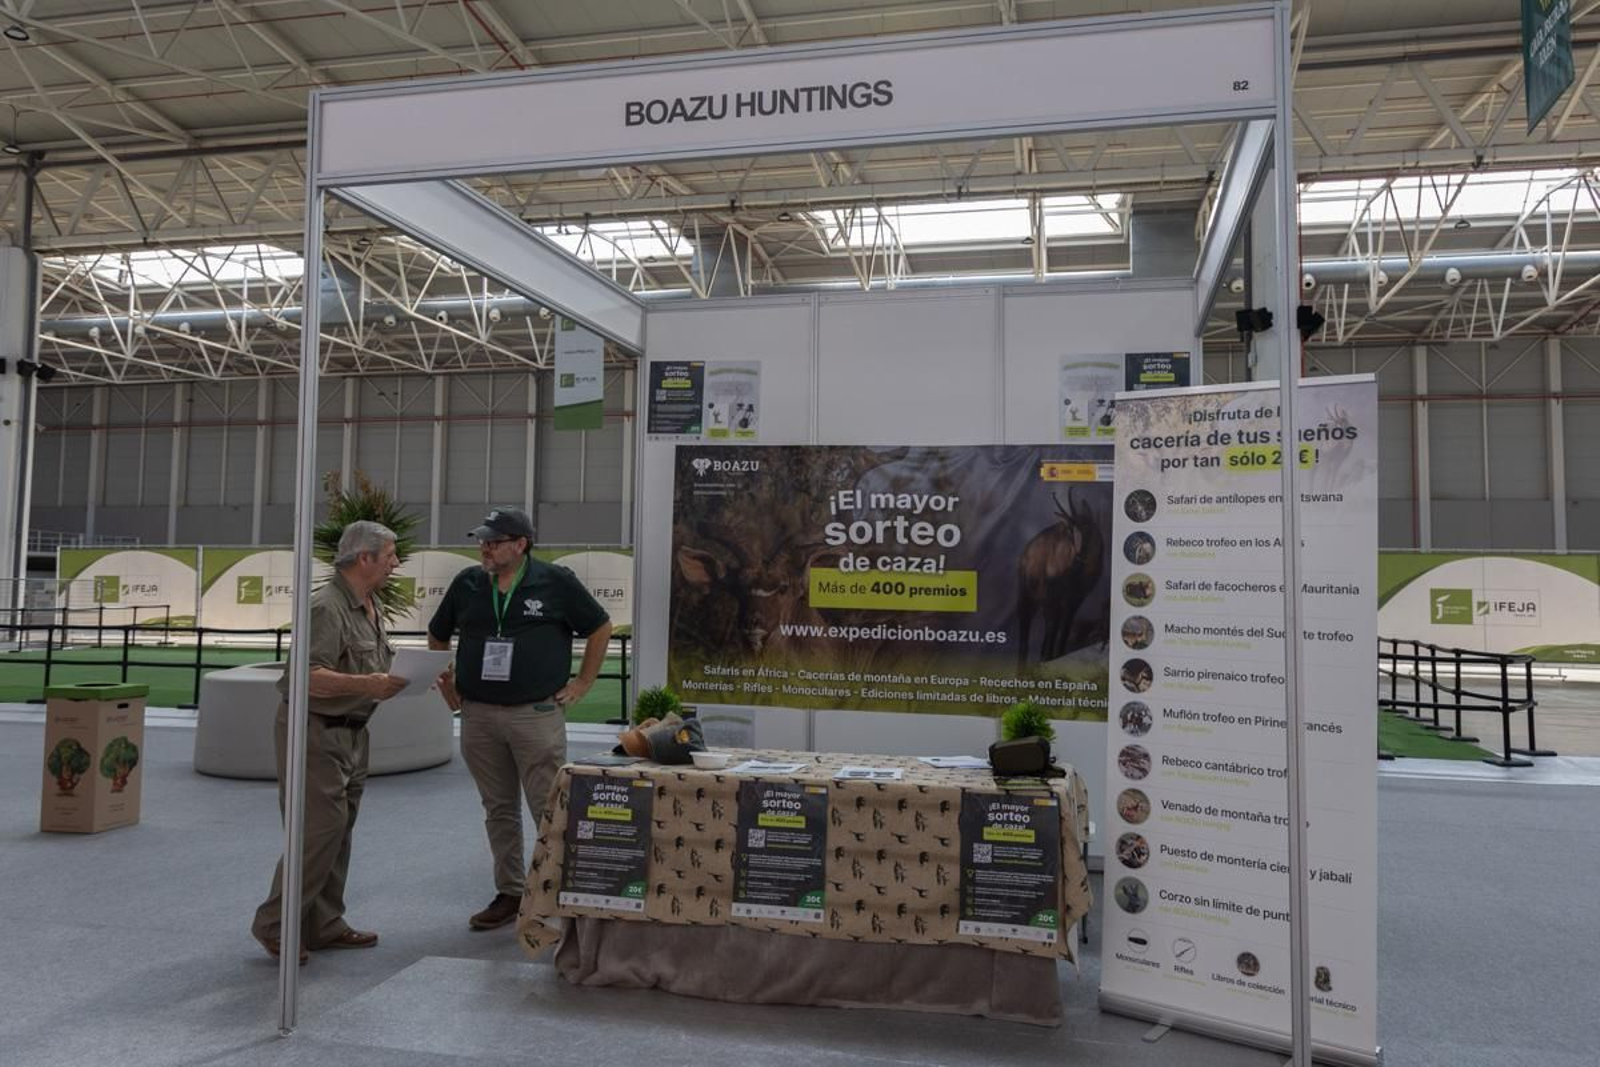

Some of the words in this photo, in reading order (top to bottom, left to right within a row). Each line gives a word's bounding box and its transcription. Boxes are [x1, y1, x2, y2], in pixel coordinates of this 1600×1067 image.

[1233, 80, 1249, 91] 82
[625, 94, 728, 127] BOAZU
[735, 80, 893, 118] HUNTINGS
[1188, 407, 1253, 425] ¡Disfruta
[1255, 407, 1272, 419] de
[1130, 430, 1201, 449] cacería
[1207, 430, 1231, 446] de
[1237, 430, 1270, 445] tus
[713, 460, 759, 472] BOAZU
[1161, 456, 1188, 472] por
[1194, 454, 1220, 468] tan
[1229, 452, 1266, 467] sólo
[1271, 450, 1309, 467] 2€
[830, 490, 862, 515] ¡El
[870, 492, 959, 514] mayor
[1167, 495, 1198, 505] Safari
[1200, 494, 1213, 504] de
[1215, 493, 1266, 505] antílopes
[1300, 492, 1344, 503] tswana
[824, 515, 961, 548] sorteo
[1166, 537, 1204, 548] Rebeco
[1206, 537, 1237, 548] trofeo
[1239, 539, 1253, 548] en
[1255, 537, 1271, 548] los
[839, 552, 870, 572] de
[877, 554, 946, 574] caza!
[132, 585, 158, 594] IFEJA
[593, 589, 623, 598] IFEJA
[818, 582, 846, 594] Más
[850, 582, 867, 594] de
[871, 581, 906, 595] 400
[909, 585, 967, 598] premios
[1165, 579, 1198, 591] Safari
[1200, 581, 1213, 591] de
[1214, 581, 1276, 593] facocheros
[1494, 601, 1536, 613] IFEJA
[779, 622, 1007, 645] www.expedicionboazu.es
[1164, 623, 1200, 635] Macho
[1203, 625, 1244, 637] montés
[1246, 627, 1264, 638] del
[1318, 630, 1354, 642] trofeo
[704, 665, 740, 676] Safaris
[742, 668, 755, 677] en
[757, 664, 789, 679] África
[798, 670, 845, 682] Cacerías
[847, 672, 861, 682] de
[862, 673, 911, 685] montaña
[914, 676, 928, 685] en
[931, 675, 969, 688] Europa
[980, 677, 1035, 690] Recechos
[1038, 680, 1052, 690] en
[1055, 679, 1098, 693] España
[1163, 667, 1195, 679] Sarrio
[1197, 669, 1247, 684] pirenaico
[1250, 672, 1285, 684] trofeo
[682, 680, 735, 692] Monterías
[743, 682, 773, 693] Rifles
[782, 684, 851, 697] Monoculares
[861, 687, 914, 699] Ediciones
[916, 689, 966, 702] limitadas
[969, 692, 982, 702] de
[985, 693, 1017, 704] libros
[1029, 694, 1076, 706] Material
[1078, 697, 1110, 708] técni
[1163, 708, 1200, 720] Muflón
[1202, 711, 1236, 724] trofeo
[1238, 715, 1251, 726] en
[1255, 716, 1288, 729] Pirine
[1162, 756, 1203, 769] Rebeco
[1204, 762, 1265, 777] cantábrico
[1267, 767, 1289, 779] trof
[593, 792, 629, 802] sorteo
[762, 799, 801, 810] sorteo
[988, 811, 1030, 823] sorteo
[1161, 800, 1202, 815] Venado
[1204, 805, 1218, 817] de
[1220, 808, 1271, 824] montaña
[1160, 844, 1198, 860] Puesto
[1200, 851, 1214, 862] de
[1216, 855, 1267, 870] montería
[1309, 868, 1317, 881] y
[1319, 869, 1353, 884] jabalí
[1159, 889, 1191, 904] Corzo
[1194, 895, 1210, 908] sin
[1212, 898, 1243, 914] límite
[1245, 905, 1261, 917] de
[1263, 909, 1291, 925] punt
[1173, 964, 1194, 976] Rifles
[1211, 972, 1236, 986] Libros
[1236, 977, 1248, 988] de
[1248, 980, 1286, 996] colección
[1326, 996, 1357, 1013] técnico
